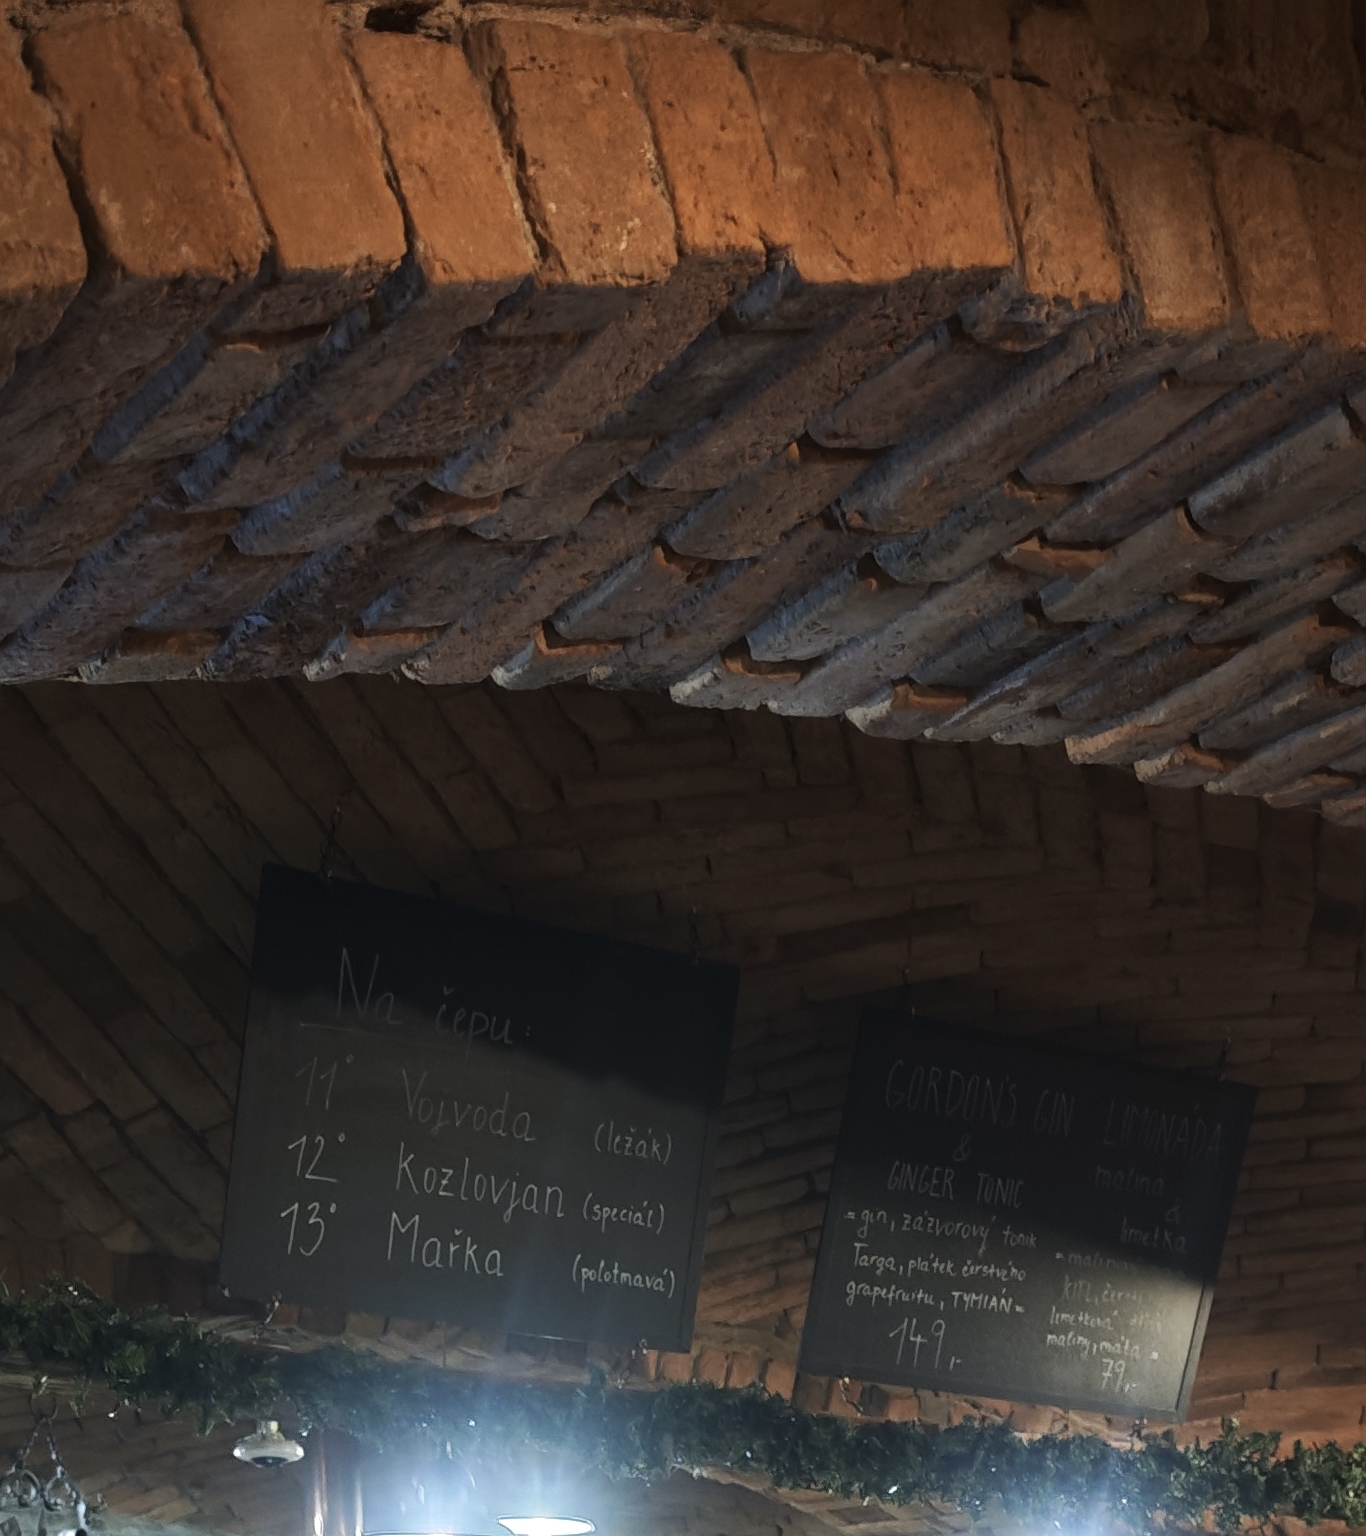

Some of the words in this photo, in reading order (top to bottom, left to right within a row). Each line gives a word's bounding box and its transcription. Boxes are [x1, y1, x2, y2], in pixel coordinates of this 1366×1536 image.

[337, 946, 403, 1025] Na
[401, 1069, 536, 1142] Vojvoda
[594, 1120, 672, 1166] (ležák)
[1034, 1088, 1075, 1140] GIN
[395, 1141, 565, 1224] Kozlovjan
[582, 1192, 665, 1235] (speciál)
[887, 1160, 956, 1201] GINGER
[975, 1172, 1025, 1210] TONIC
[387, 1210, 504, 1277] Mařka
[571, 1253, 676, 1299] (polotmavá)
[900, 1209, 997, 1258] zázvorový
[1002, 1225, 1037, 1249] tonik
[907, 1252, 957, 1278] plátek
